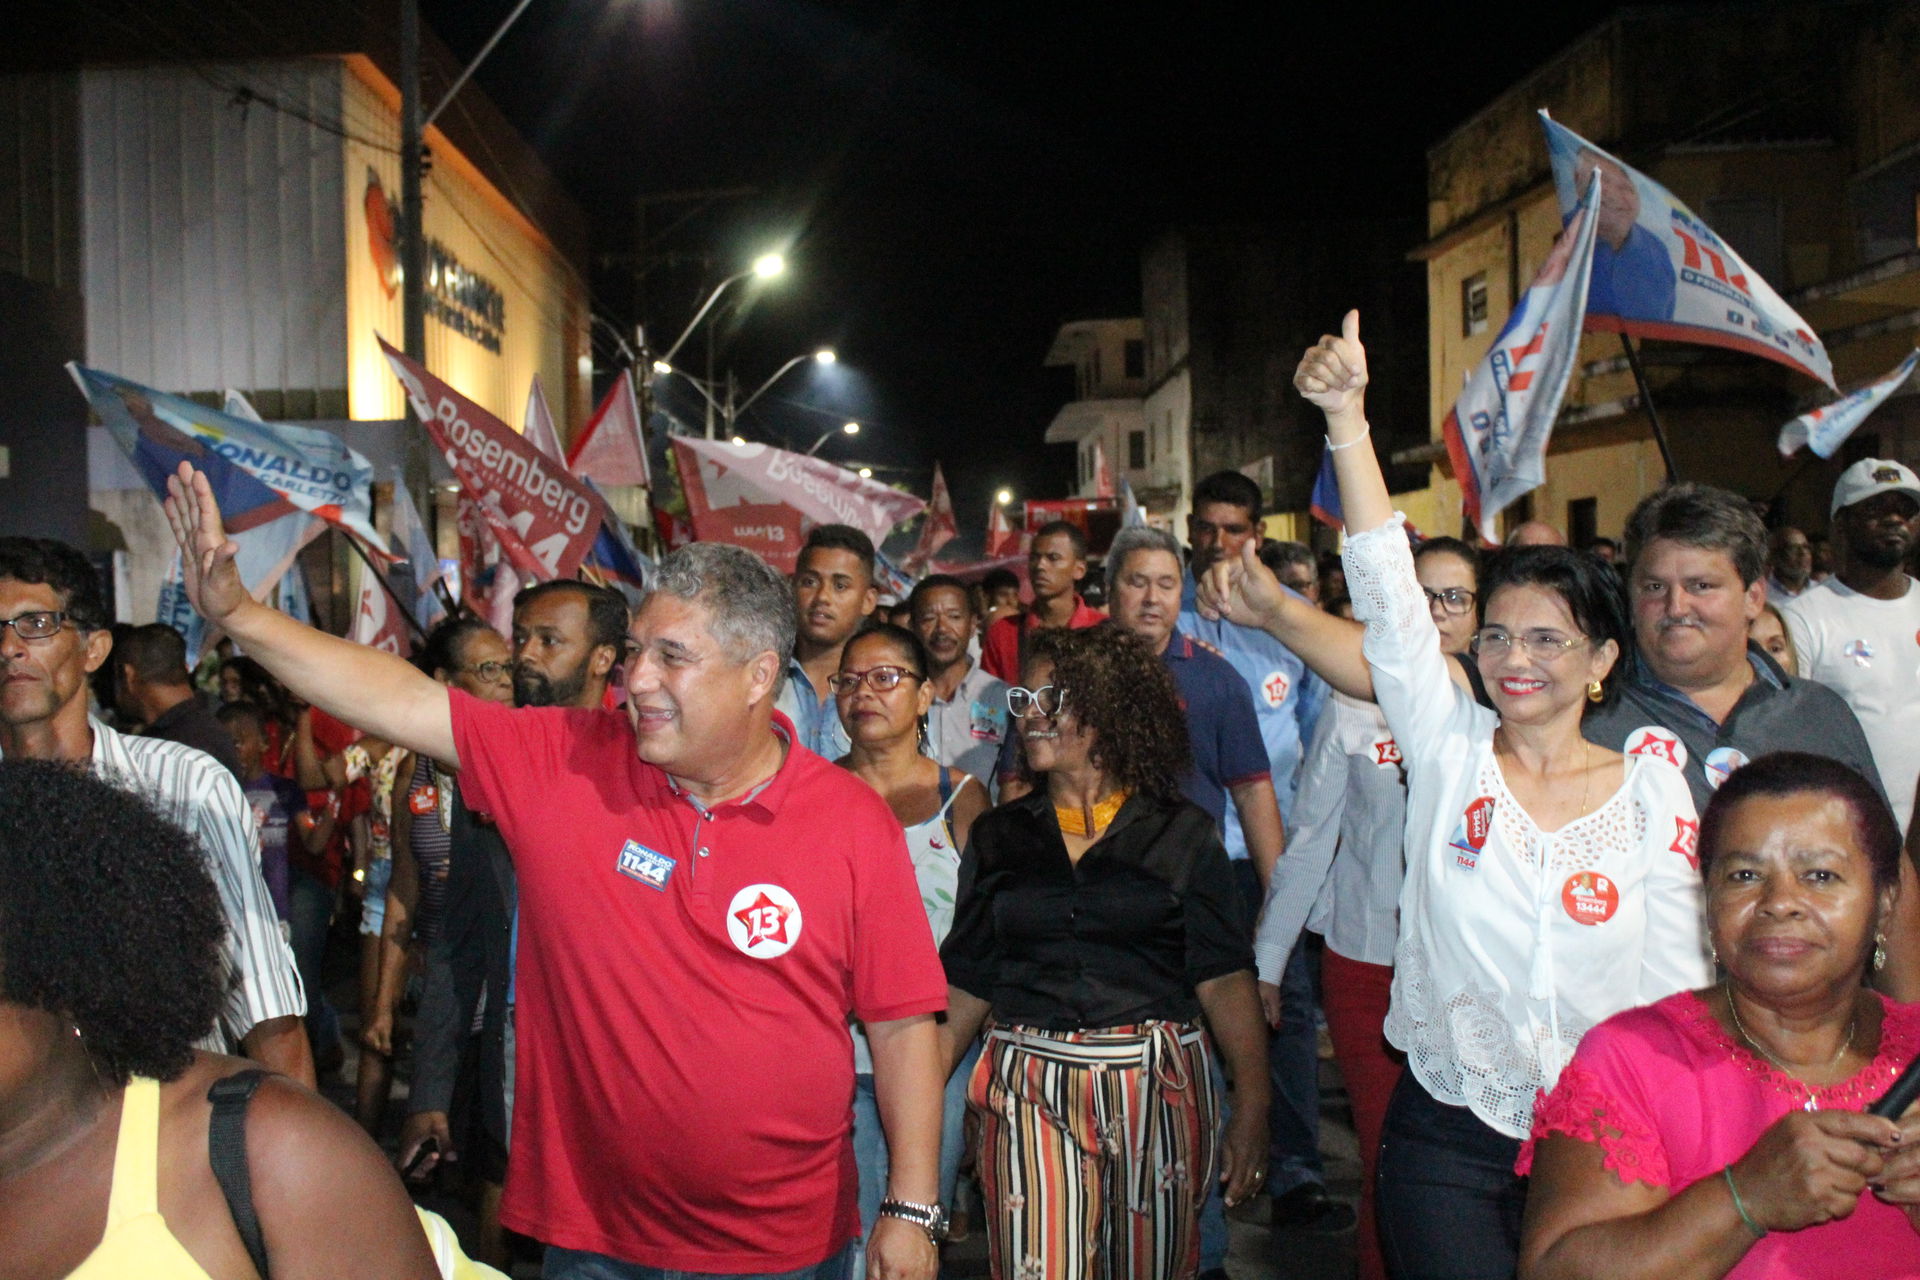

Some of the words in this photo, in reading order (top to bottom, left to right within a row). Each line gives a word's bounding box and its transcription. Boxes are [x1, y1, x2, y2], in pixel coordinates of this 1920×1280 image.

[436, 396, 591, 535] Rosemberg
[622, 850, 667, 883] 1144
[626, 843, 673, 868] RONALDO
[1457, 856, 1475, 868] 1144
[748, 905, 781, 936] 13
